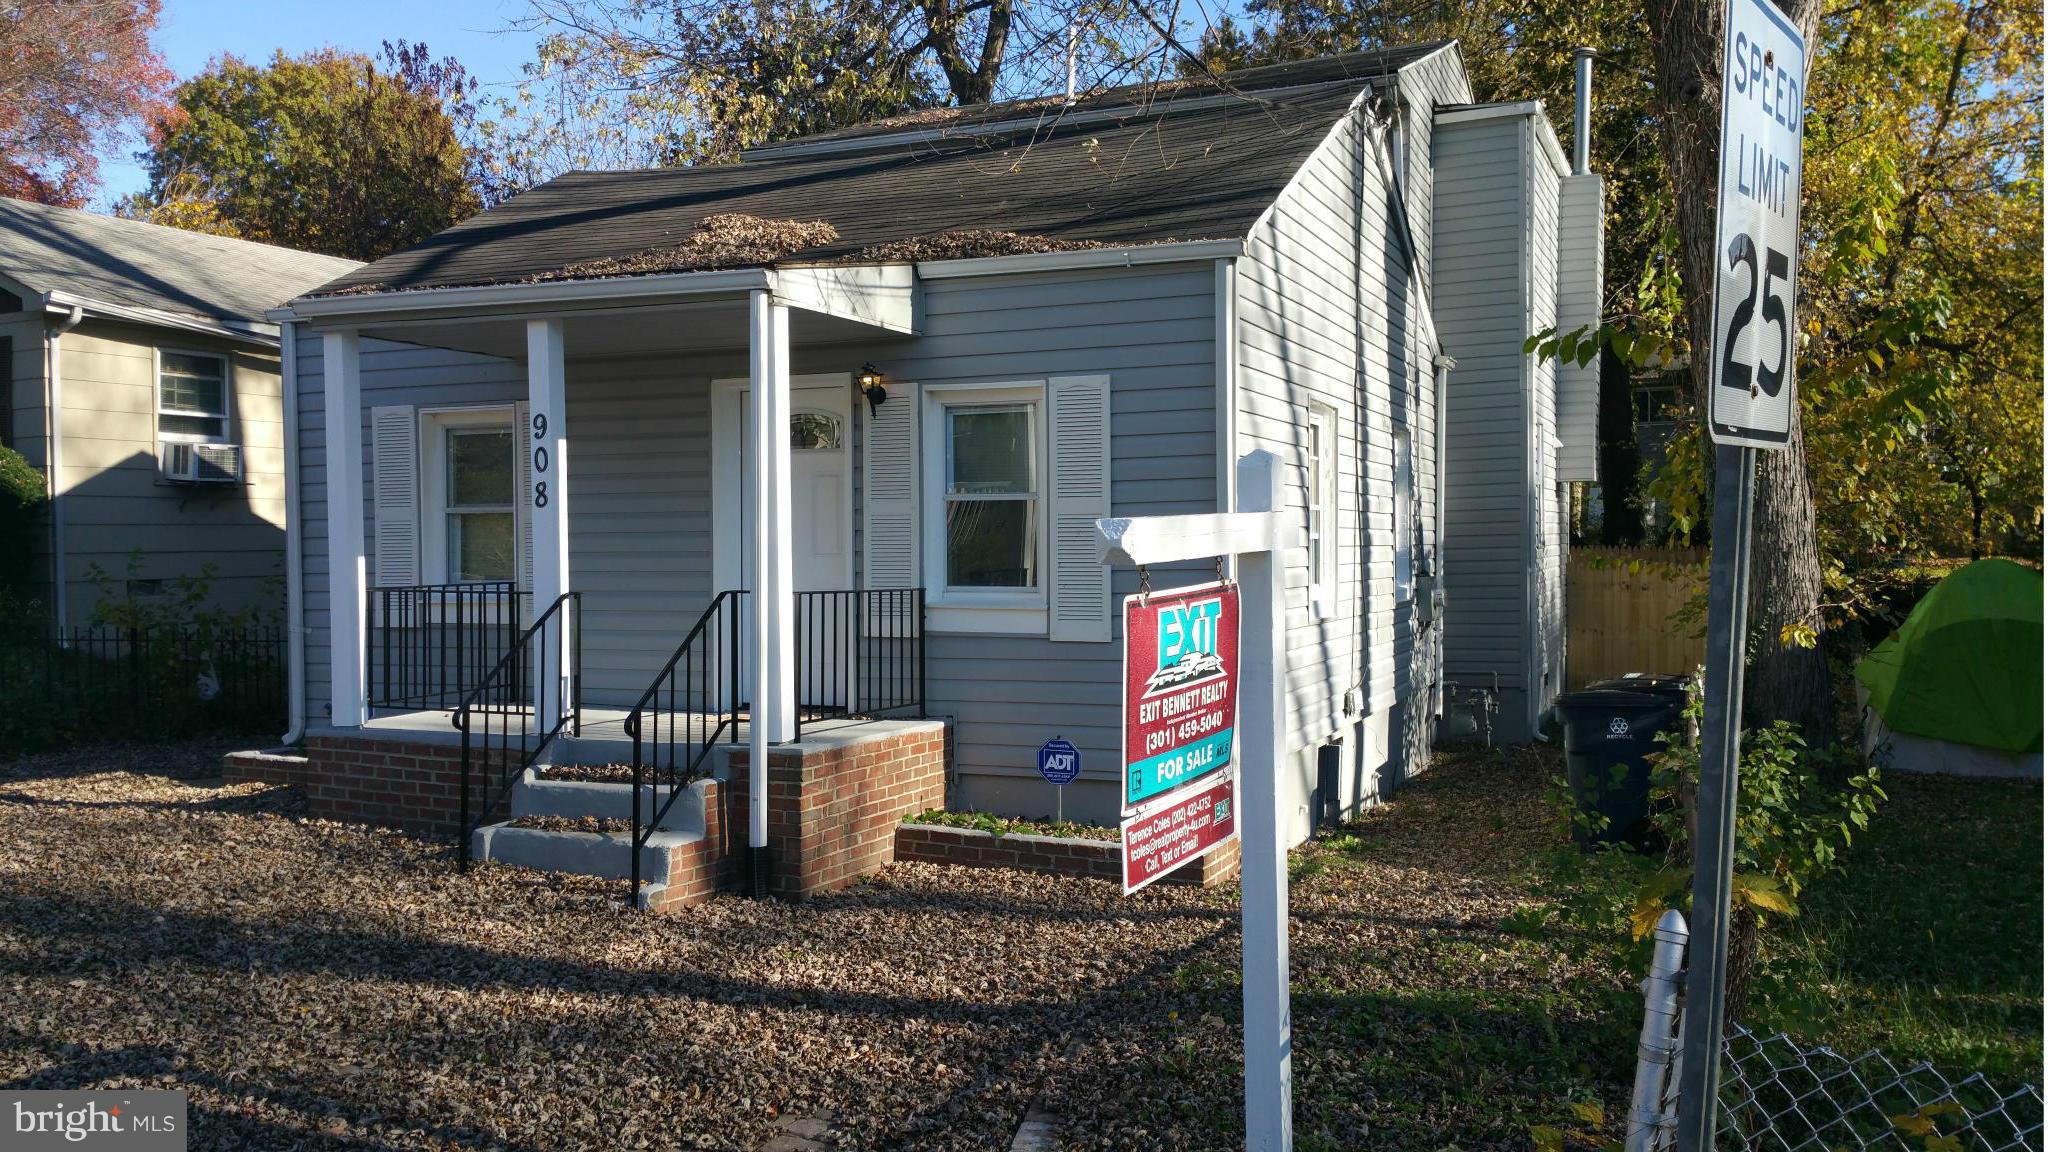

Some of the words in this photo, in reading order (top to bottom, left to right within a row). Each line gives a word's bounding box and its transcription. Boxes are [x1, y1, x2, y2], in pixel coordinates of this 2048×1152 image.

[1734, 31, 1798, 134] SPEED
[1738, 134, 1789, 218] LIMIT
[1721, 232, 1789, 398] 25
[533, 413, 548, 508] 908
[1159, 600, 1221, 669] EXIT
[1141, 702, 1161, 724] EXIT
[1163, 690, 1200, 717] BENNETT
[1202, 681, 1228, 703] REALTY
[1147, 727, 1175, 754] (301)
[1179, 711, 1222, 739] 459-5040
[1044, 754, 1074, 770] ADT
[1157, 756, 1184, 783] FOR
[1186, 743, 1213, 771] SALE
[1153, 819, 1170, 834] Coles
[1171, 807, 1186, 828] (202)
[1187, 795, 1212, 816] 422-4752
[1214, 798, 1230, 819] EXIT
[1145, 855, 1159, 872] Call,
[1161, 849, 1173, 864] Text
[1174, 848, 1180, 858] or
[1181, 835, 1199, 854] Email!
